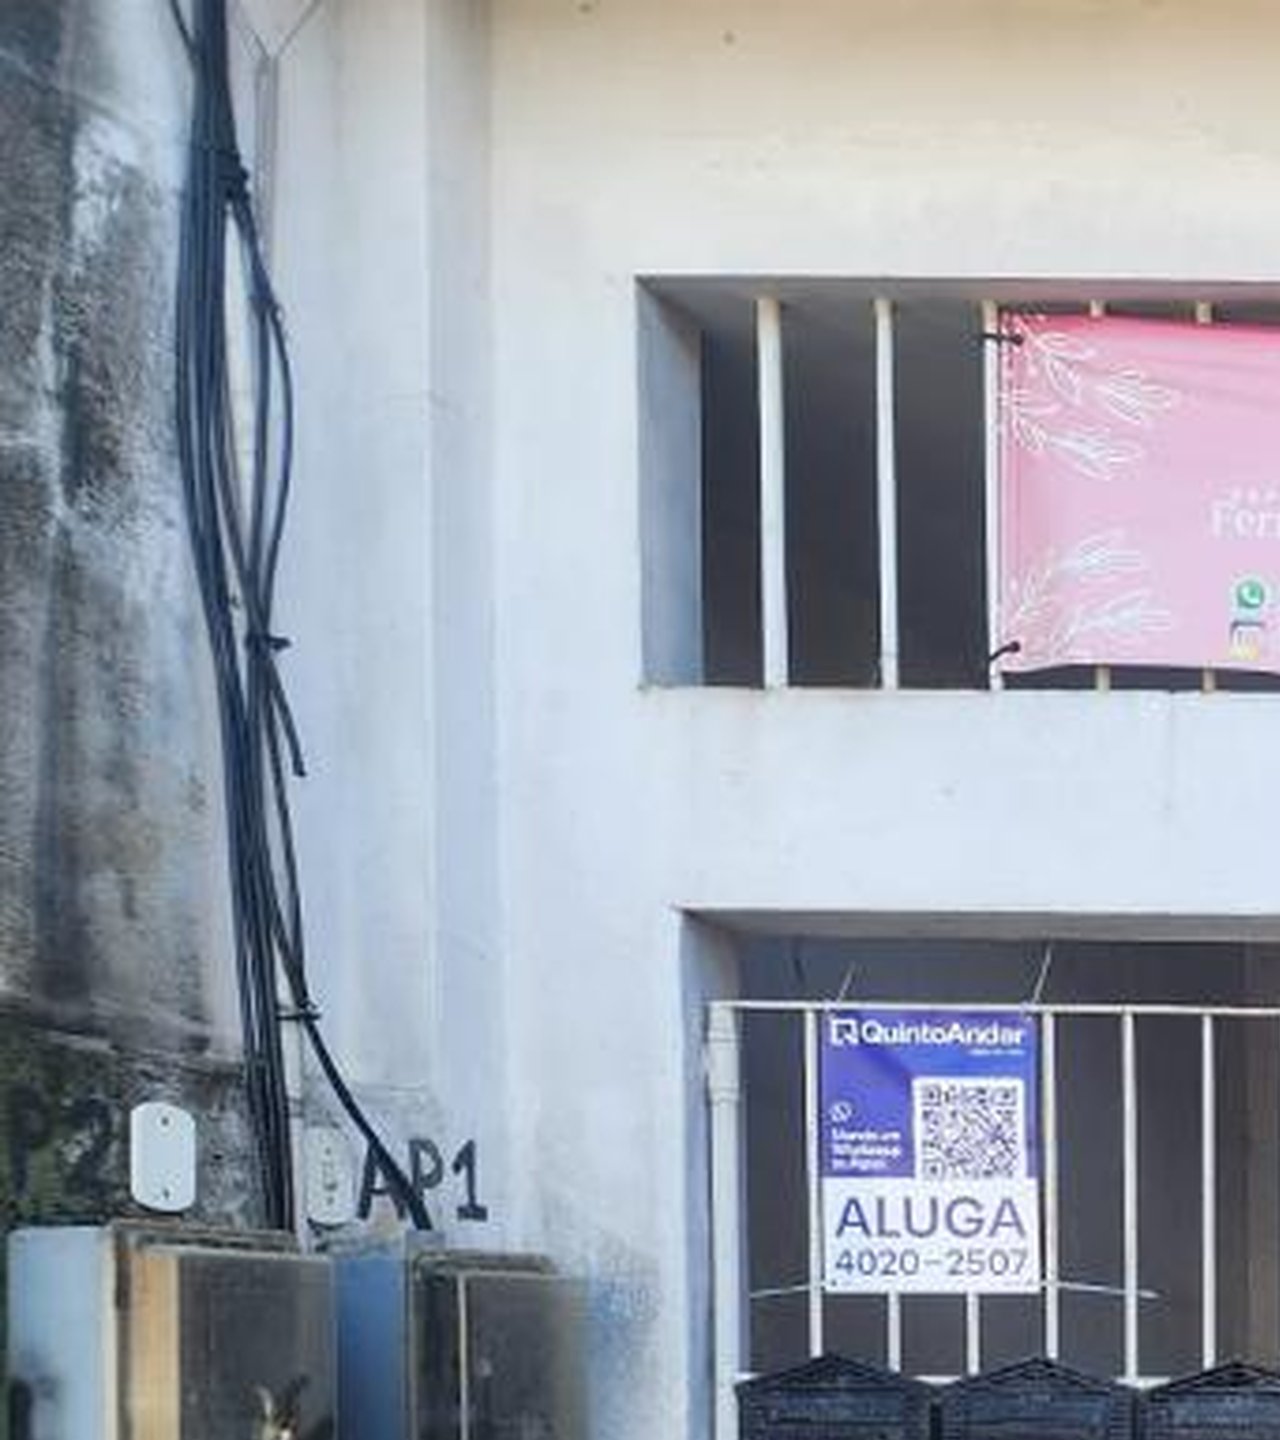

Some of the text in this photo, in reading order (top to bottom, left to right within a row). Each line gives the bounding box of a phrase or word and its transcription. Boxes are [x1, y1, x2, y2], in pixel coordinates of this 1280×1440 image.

[862, 1018, 1026, 1045] QuintoAndar
[836, 1197, 1026, 1239] ALUGA
[835, 1249, 1028, 1276] 4020-2507
